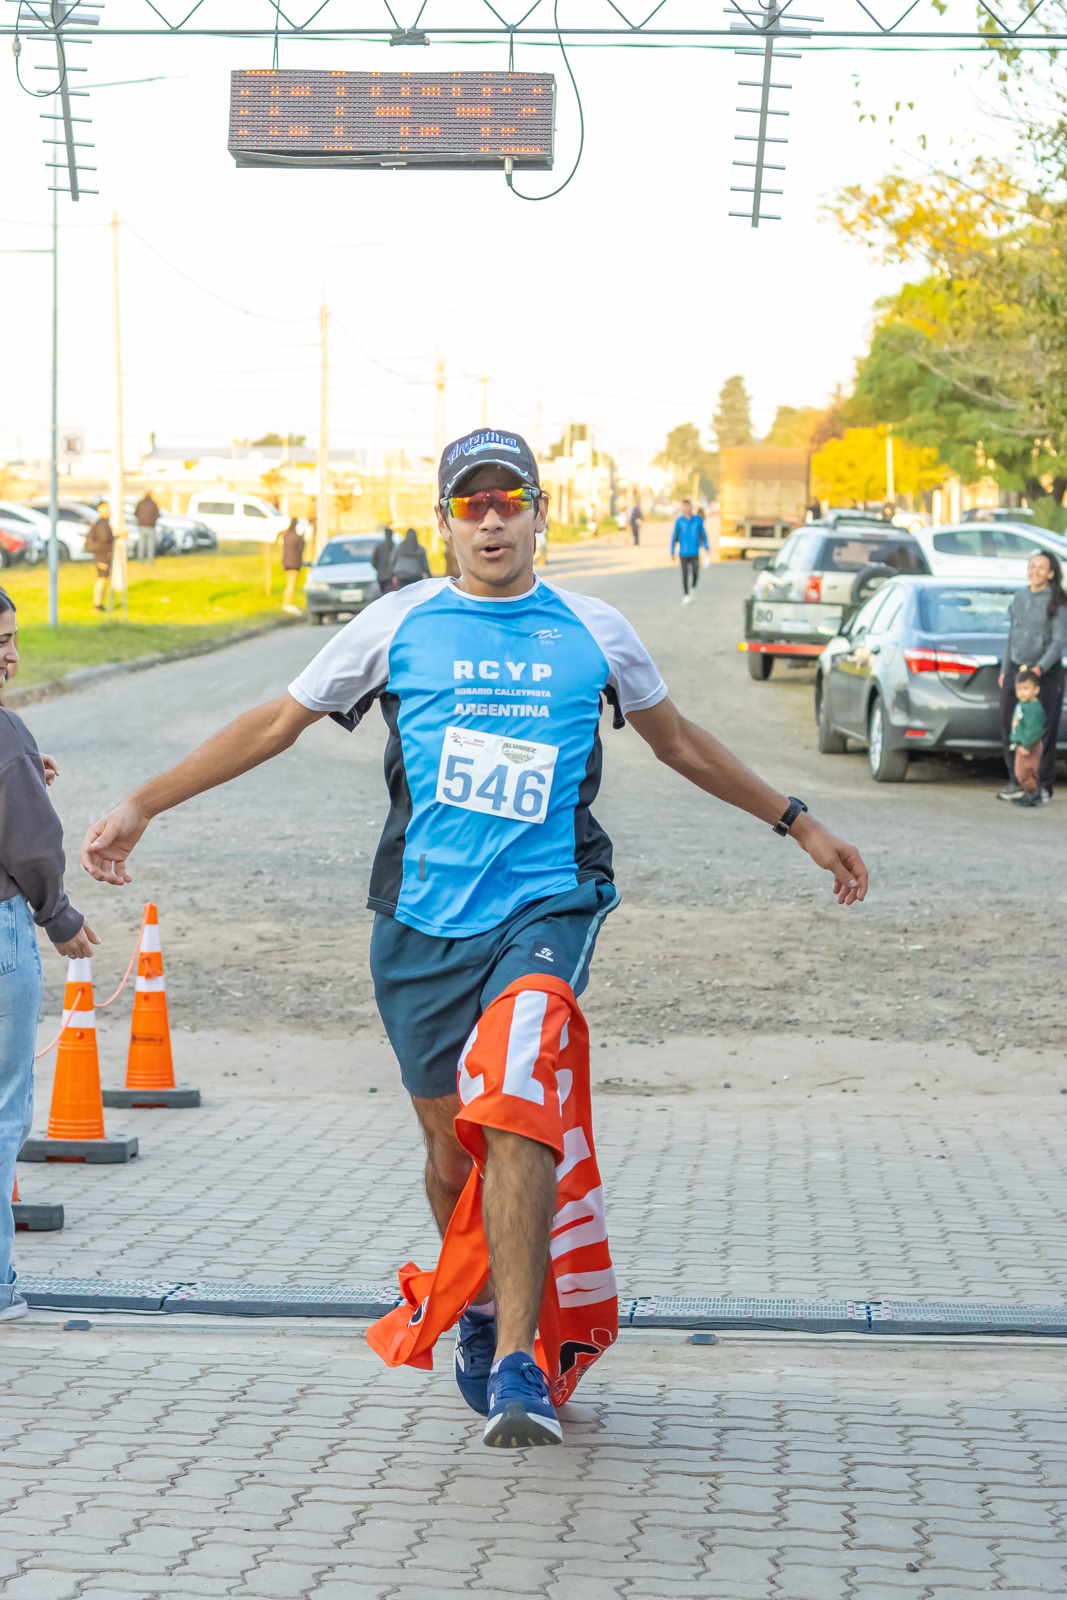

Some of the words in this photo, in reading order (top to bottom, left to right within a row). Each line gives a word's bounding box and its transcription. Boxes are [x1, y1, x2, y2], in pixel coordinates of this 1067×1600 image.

[454, 687, 493, 695] ROSARIO
[494, 688, 552, 698] CALLEYPISTA
[453, 703, 550, 718] ARGENTINA
[443, 754, 546, 818] 546
